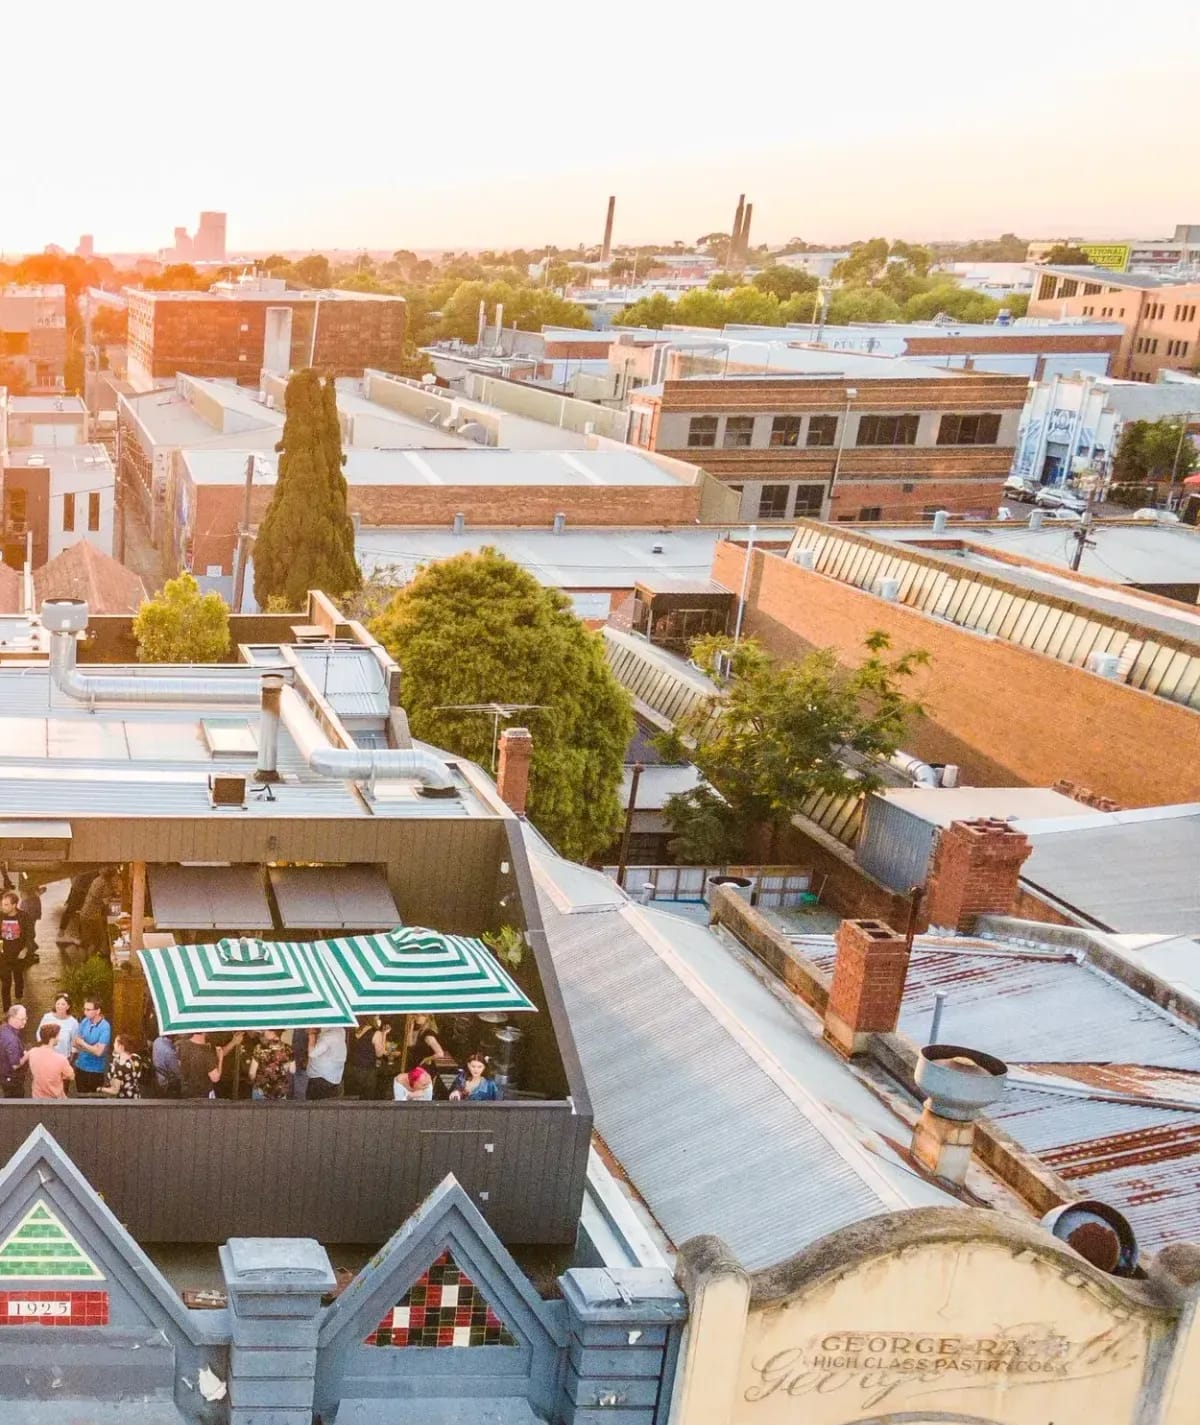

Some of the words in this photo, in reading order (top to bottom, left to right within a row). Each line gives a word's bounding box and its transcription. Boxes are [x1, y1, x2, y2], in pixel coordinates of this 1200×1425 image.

[16, 1302, 68, 1315] 1925
[820, 1335, 961, 1356] GEORGE
[813, 1356, 858, 1369] HIGH
[863, 1357, 929, 1370] CLASS
